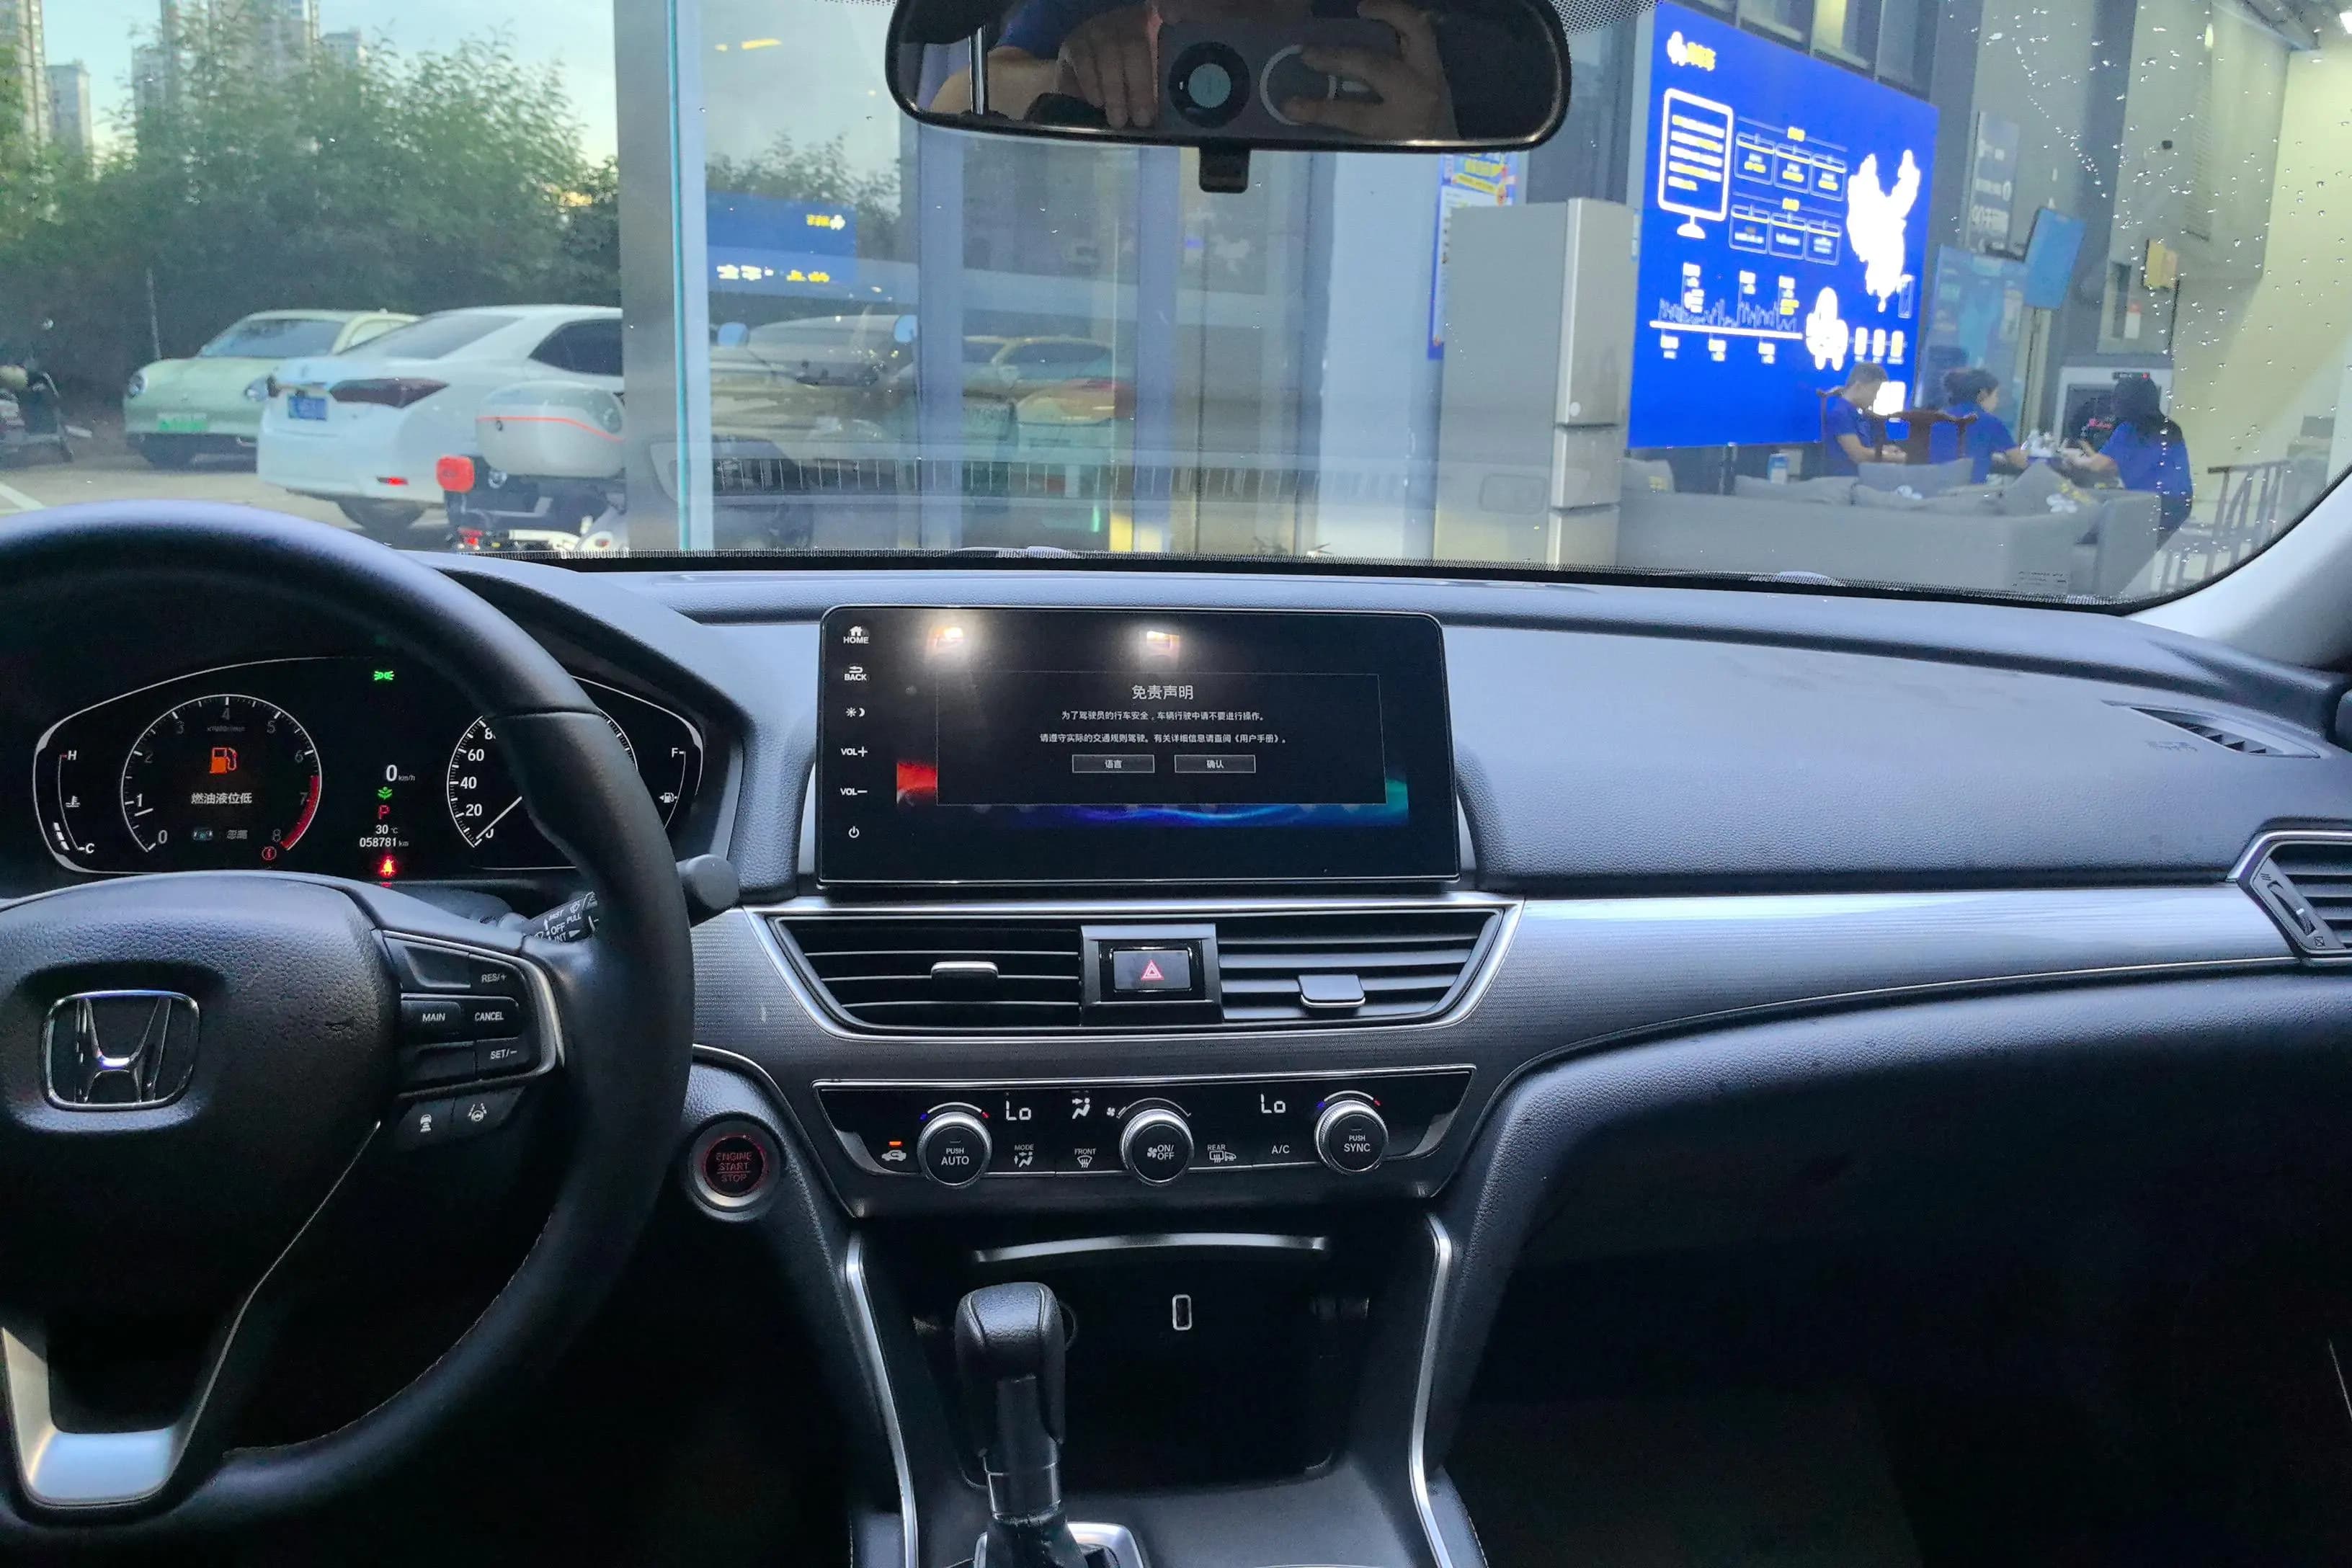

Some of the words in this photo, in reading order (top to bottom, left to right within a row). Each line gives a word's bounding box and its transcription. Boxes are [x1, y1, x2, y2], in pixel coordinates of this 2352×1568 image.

[843, 633, 869, 644] HOME
[844, 670, 867, 681] BACK
[1131, 684, 1194, 700] 免责声明
[221, 707, 231, 721] 4
[177, 721, 185, 735] 3
[267, 720, 277, 734] 5
[67, 749, 77, 761] H
[144, 751, 153, 764] 2
[295, 750, 303, 763] 6
[467, 748, 485, 762] 60
[671, 747, 680, 758] F
[840, 746, 868, 757] VOL+
[1105, 759, 1123, 769] 语言
[1206, 760, 1224, 769] 确认
[386, 764, 398, 782] 0
[460, 776, 478, 790] 40
[135, 793, 143, 807] 1
[191, 792, 252, 805] 燃油液位低
[300, 791, 308, 805] 7
[378, 804, 391, 820] P
[466, 803, 483, 816] 20
[375, 824, 389, 834] 30
[158, 829, 168, 845] 0
[272, 829, 282, 843] 8
[359, 837, 397, 847] 058781
[85, 842, 95, 854] C
[566, 913, 582, 924] PULL
[551, 922, 566, 935] OFF
[481, 973, 507, 983] RES/+
[422, 1012, 446, 1022] MAIN
[474, 1011, 504, 1021] CANCEL
[1260, 1093, 1286, 1114] Lo
[1005, 1100, 1032, 1121] Lo
[1157, 1144, 1175, 1153] ON/
[1271, 1144, 1290, 1154] A/C
[1343, 1143, 1371, 1153] SYNC
[715, 1152, 752, 1162] ENGINE
[940, 1155, 970, 1166] AUTO
[1157, 1152, 1175, 1161] OFF
[718, 1162, 750, 1172] START
[720, 1174, 748, 1183] STOP
